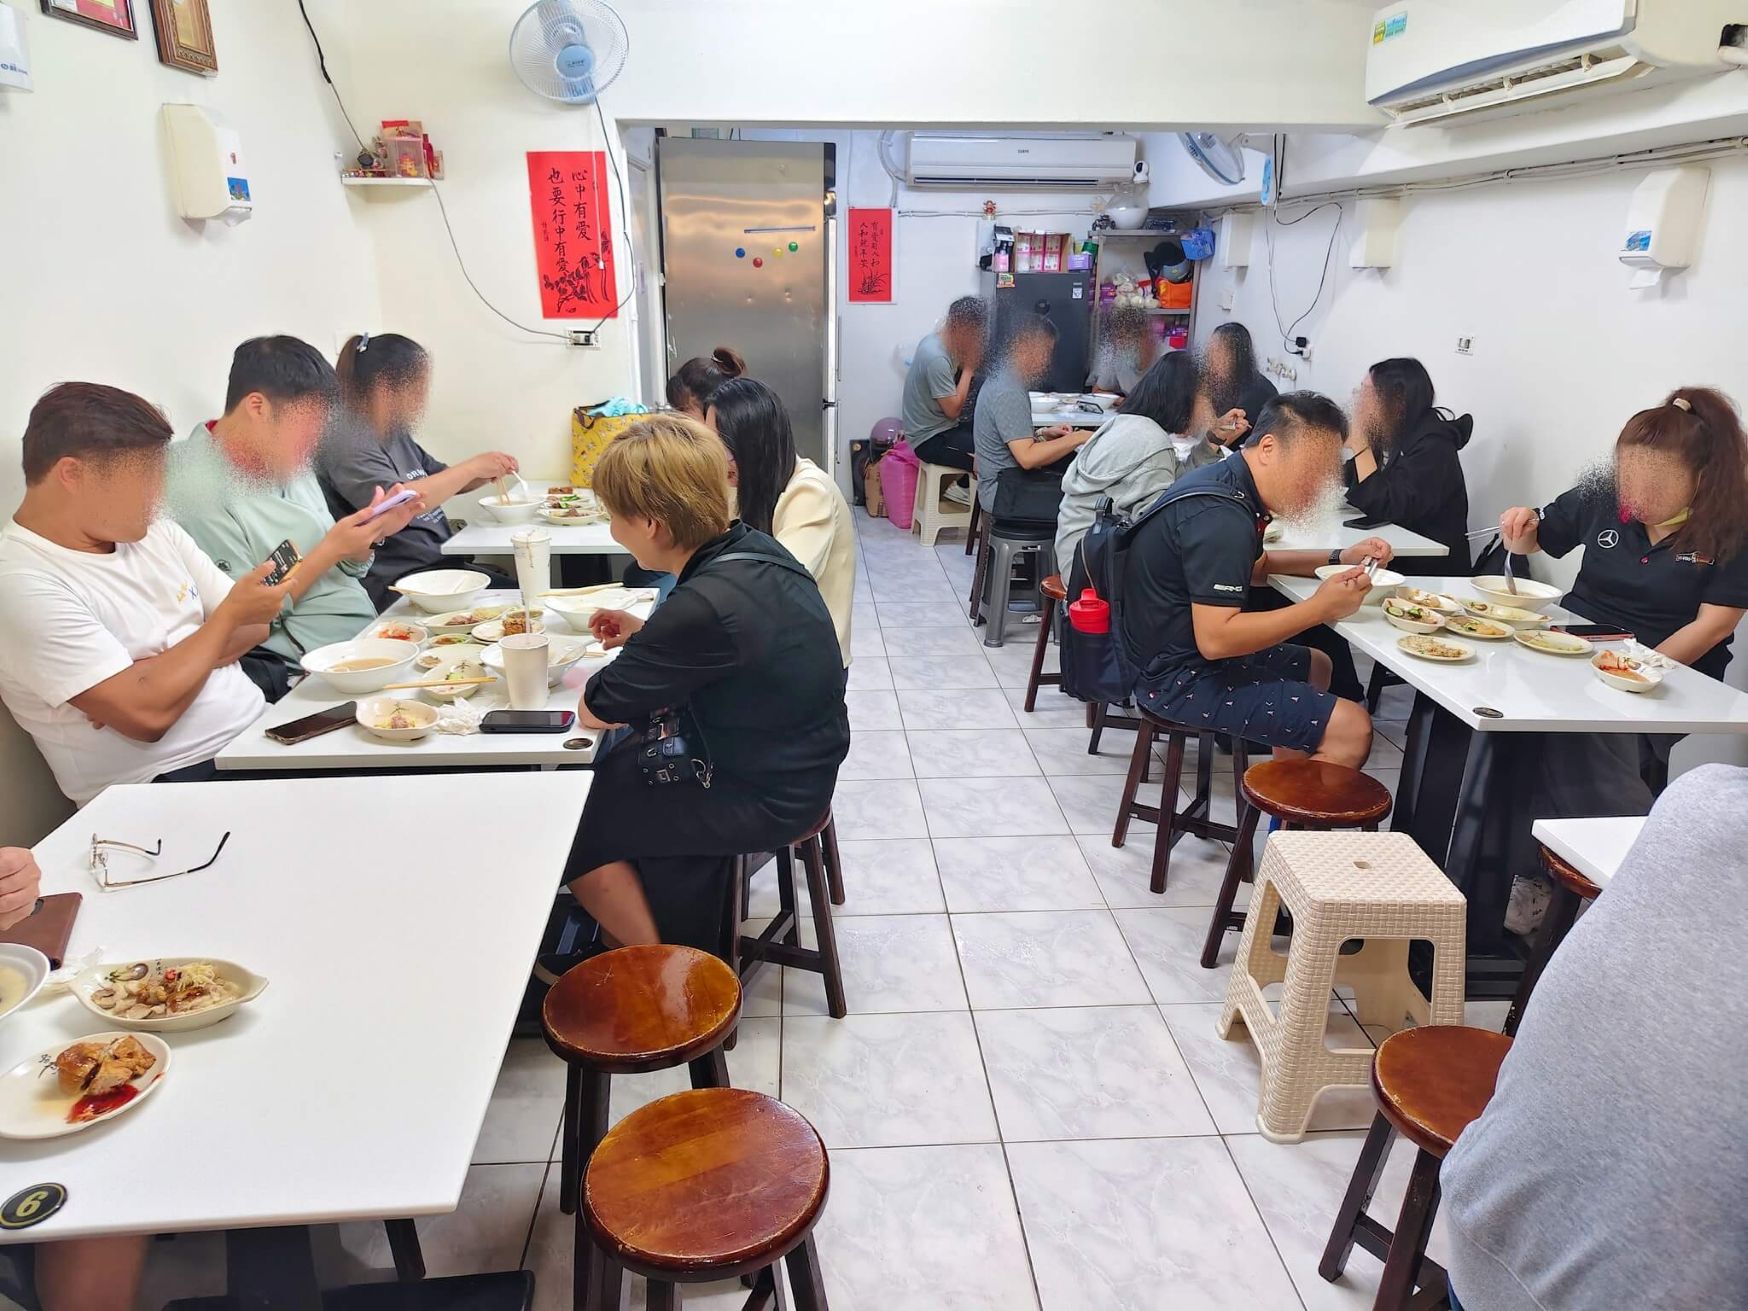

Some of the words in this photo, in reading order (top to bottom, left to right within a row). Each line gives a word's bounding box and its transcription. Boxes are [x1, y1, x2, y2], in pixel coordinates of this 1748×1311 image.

[547, 167, 569, 275] 也要行中有愛
[572, 169, 592, 241] 心中有愛
[15, 1190, 49, 1217] 6
